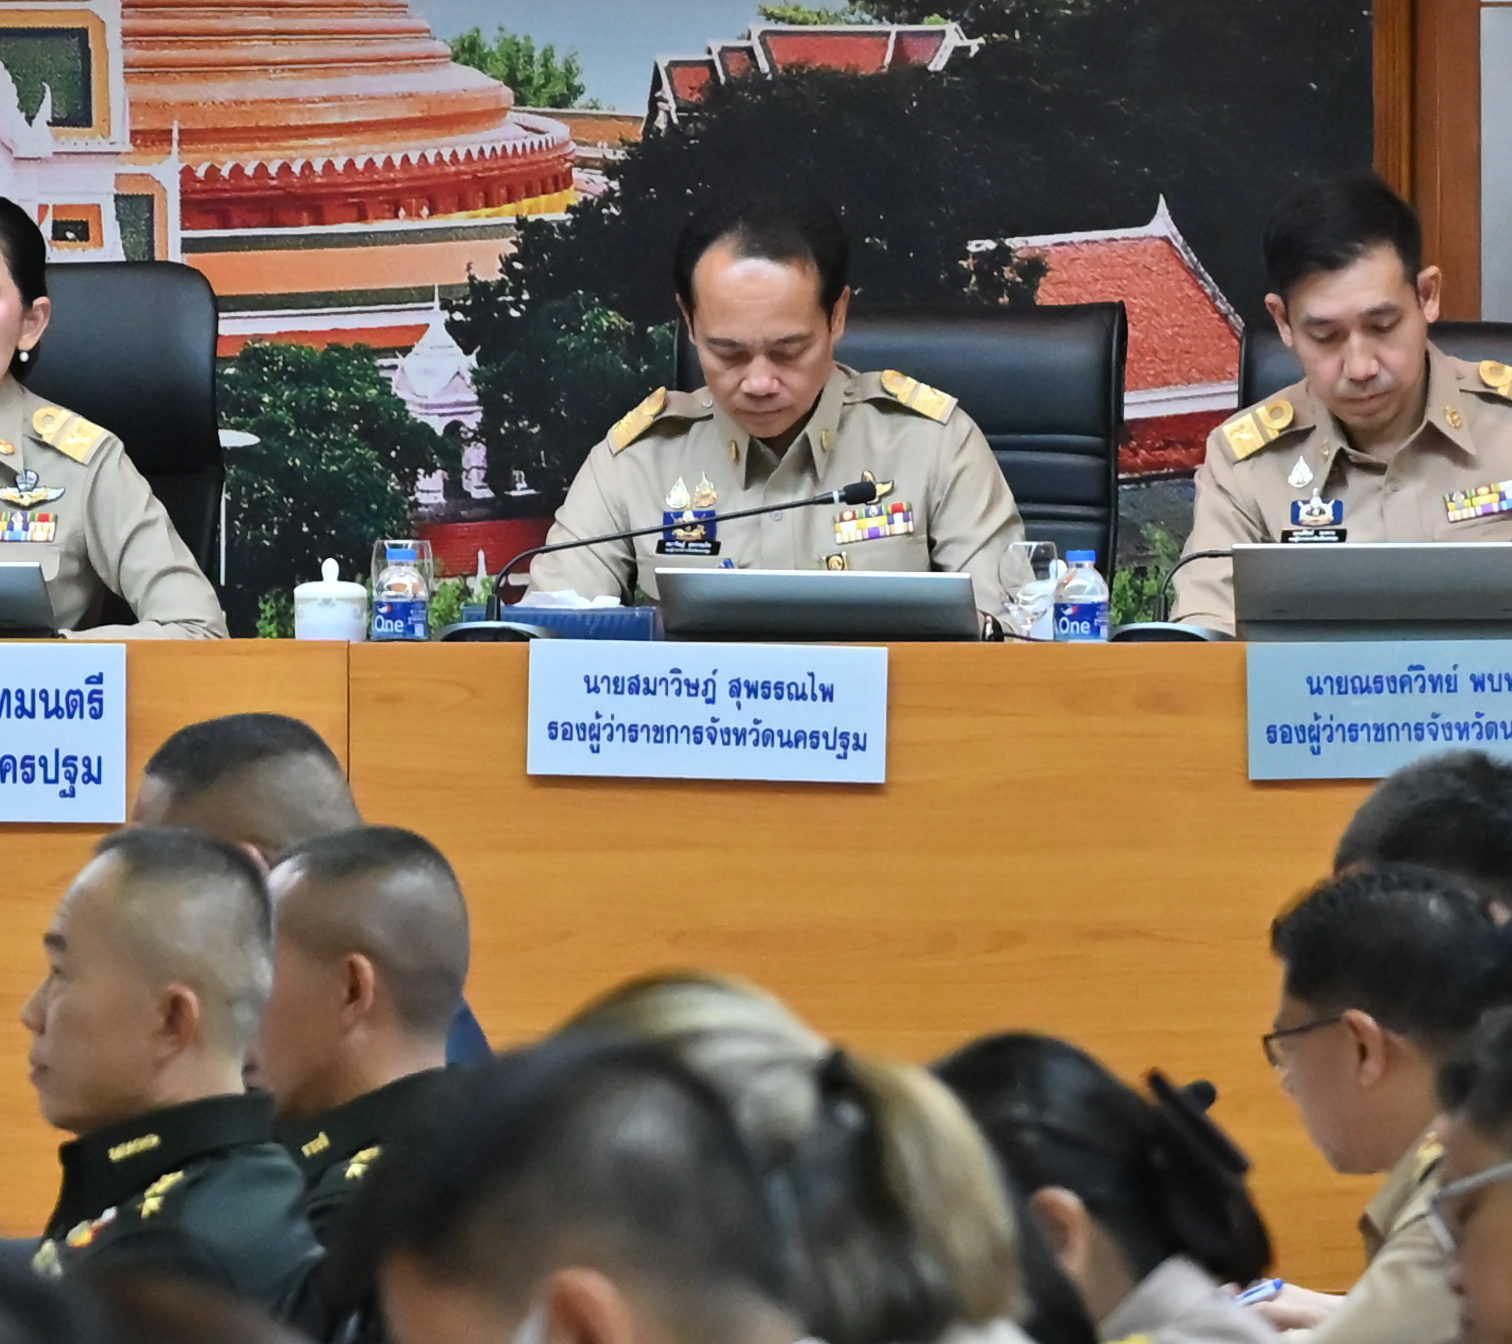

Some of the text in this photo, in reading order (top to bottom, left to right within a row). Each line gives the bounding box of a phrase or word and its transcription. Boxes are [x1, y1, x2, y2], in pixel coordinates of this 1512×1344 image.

[727, 671, 836, 711] สุพรรณไพ
[546, 710, 869, 761] รองผู้ว่าราชการจังหวัดนครปฐม
